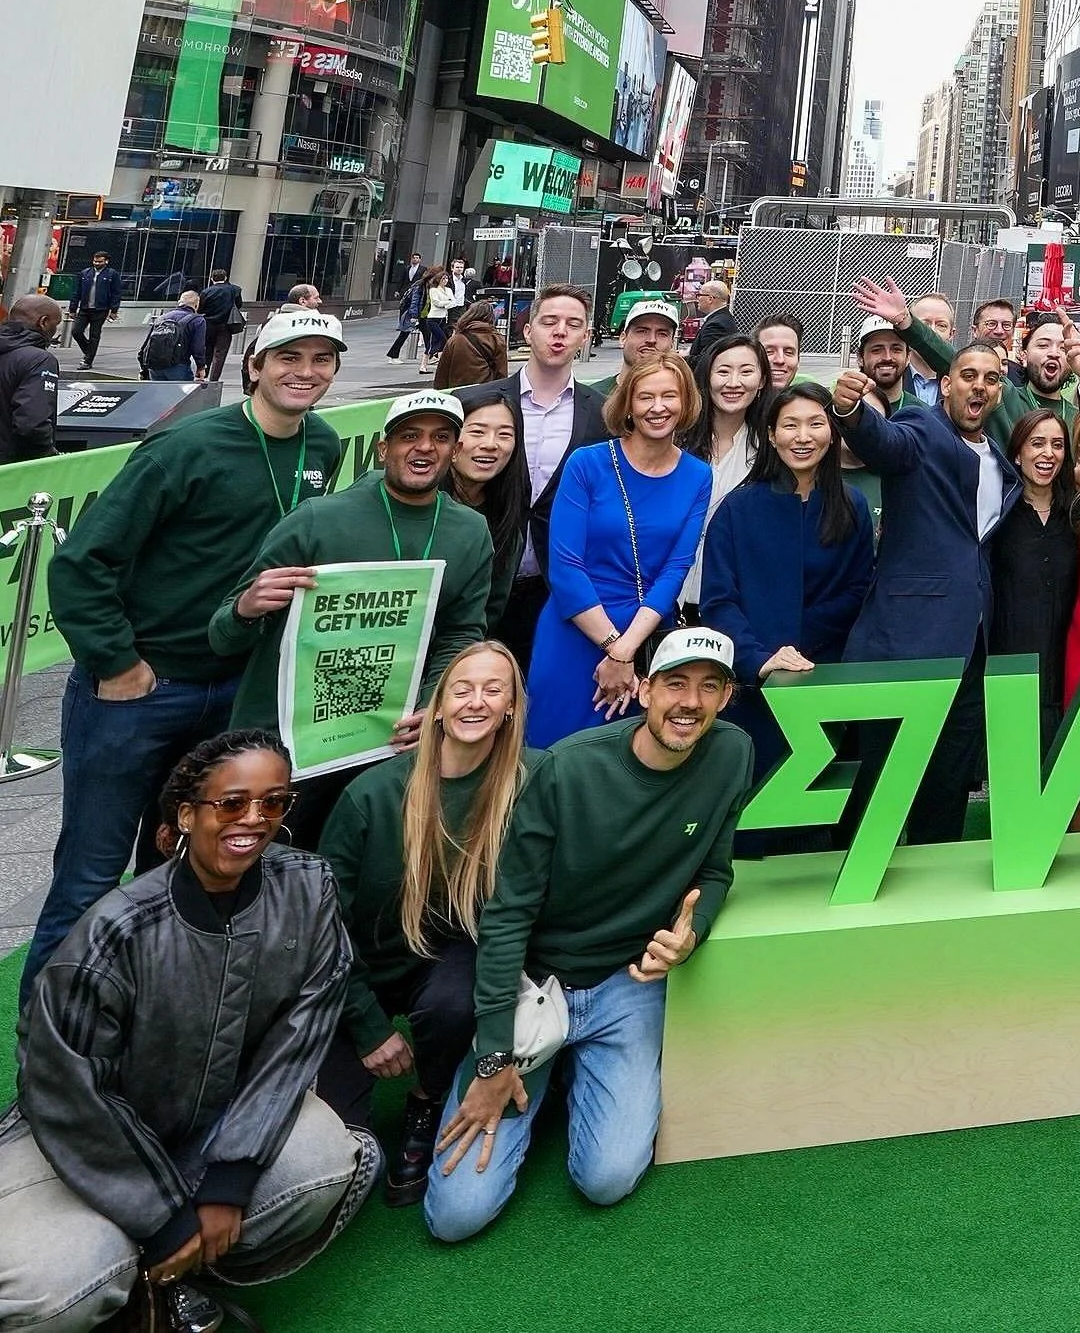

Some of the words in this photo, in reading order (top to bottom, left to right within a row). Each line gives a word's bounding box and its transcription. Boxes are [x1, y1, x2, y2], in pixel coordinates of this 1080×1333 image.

[166, 36, 242, 57] TOMORROW
[625, 174, 648, 189] H&M
[312, 319, 329, 328] NY
[427, 397, 445, 406] NY
[314, 594, 341, 613] BE
[343, 590, 418, 611] SMART
[314, 613, 357, 633] GET
[359, 610, 410, 629] WISE
[705, 639, 723, 652] NY
